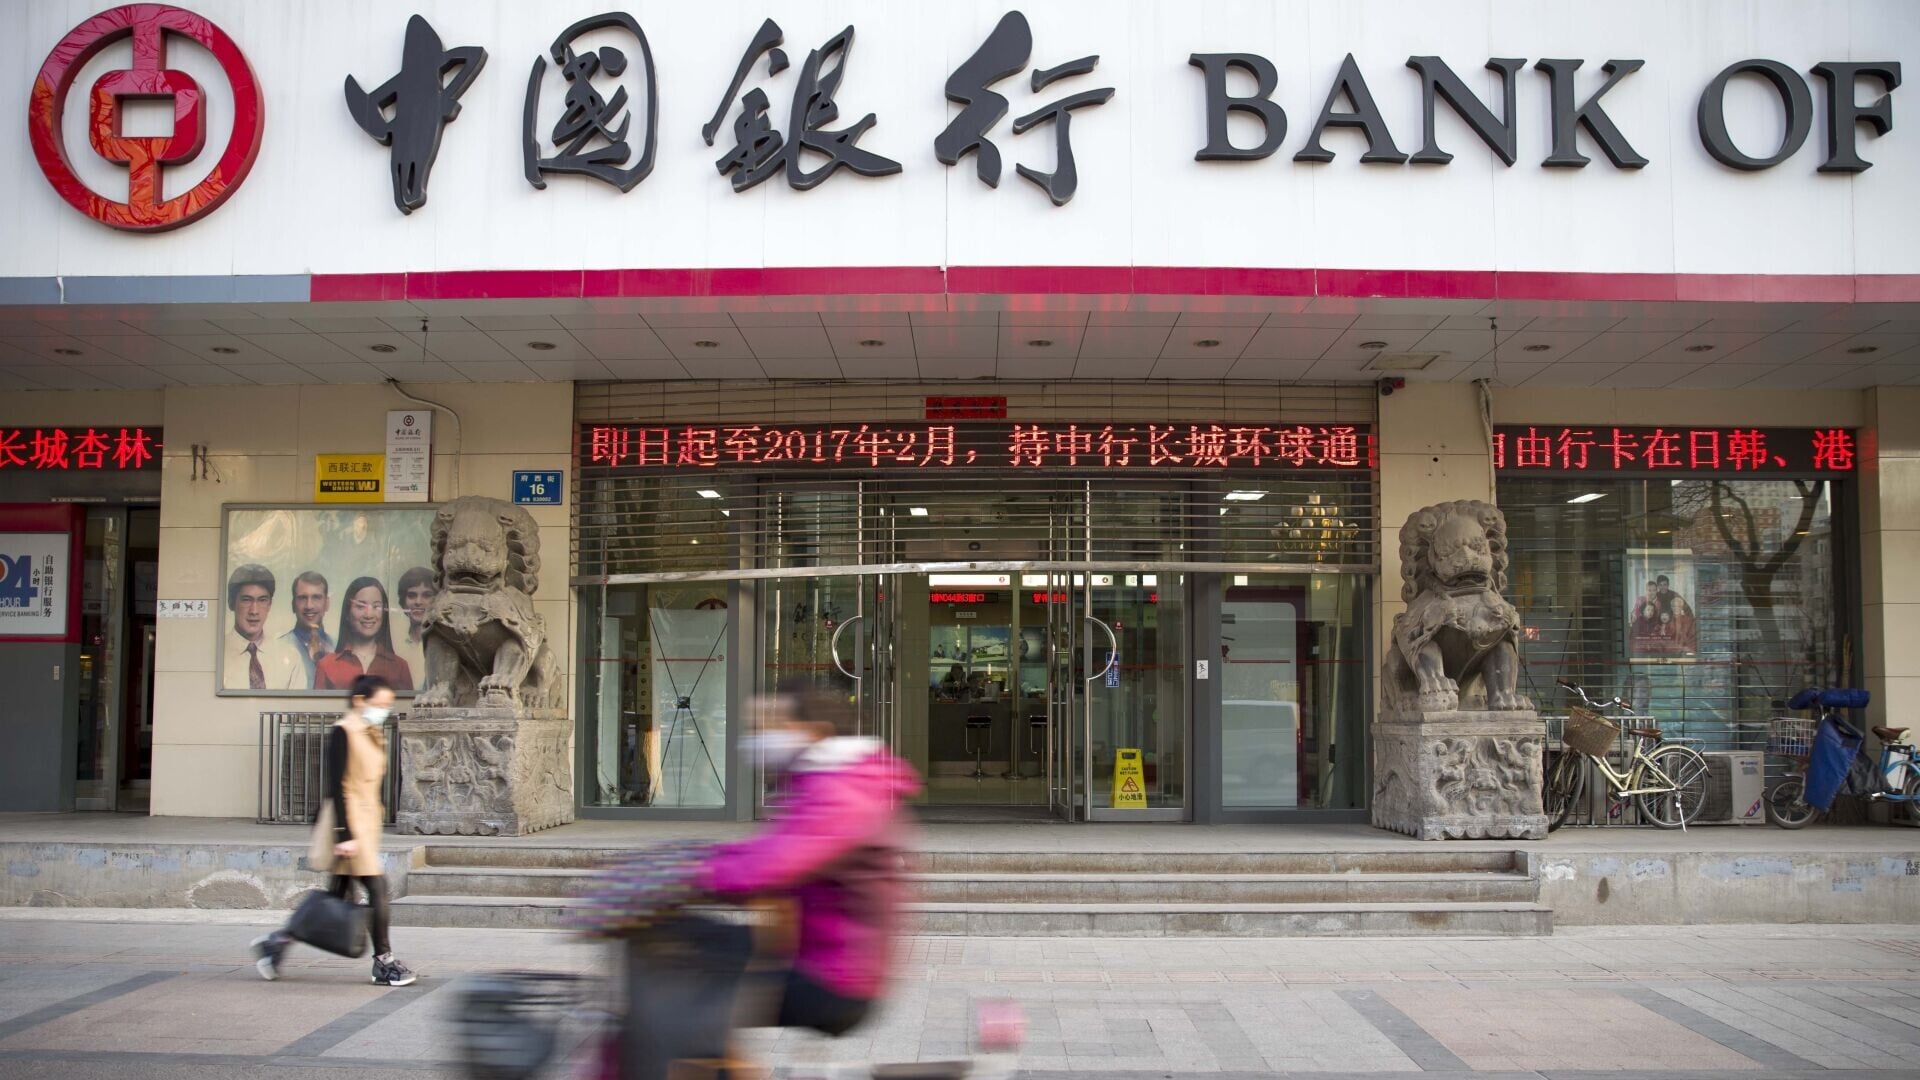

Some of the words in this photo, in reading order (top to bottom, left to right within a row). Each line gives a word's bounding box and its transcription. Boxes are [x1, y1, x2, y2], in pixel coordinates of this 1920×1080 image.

[1189, 52, 1650, 170] BANK
[1697, 58, 1902, 173] OF
[0, 427, 163, 469] 长城杏林
[328, 462, 373, 473] 西联汇款
[356, 480, 377, 491] WU
[529, 483, 545, 495] 16
[33, 568, 40, 586] 小时
[44, 554, 53, 618] 自助银行服务
